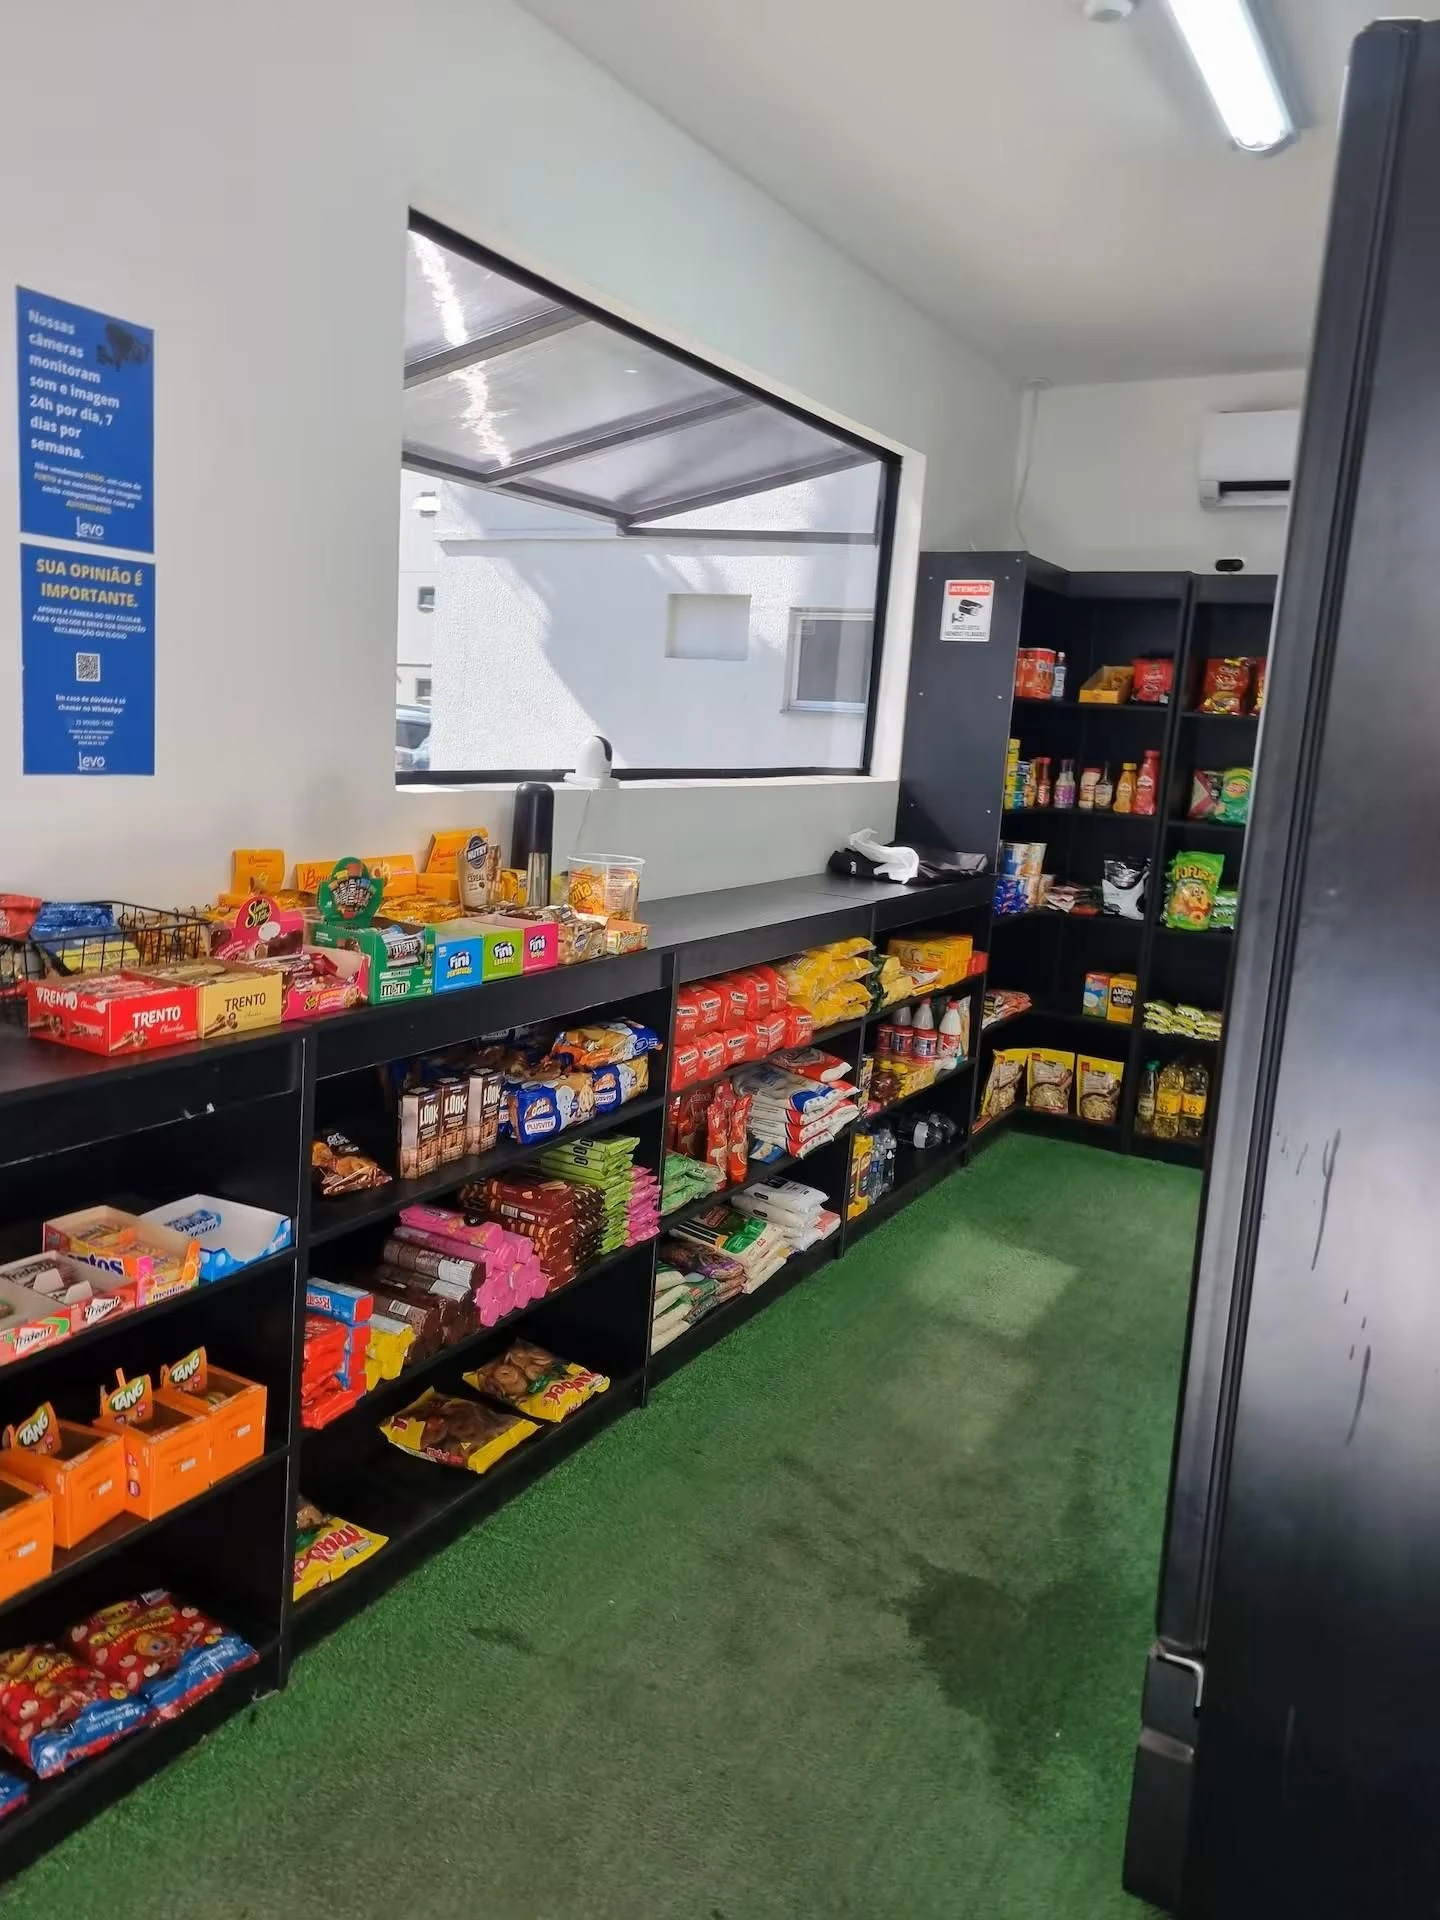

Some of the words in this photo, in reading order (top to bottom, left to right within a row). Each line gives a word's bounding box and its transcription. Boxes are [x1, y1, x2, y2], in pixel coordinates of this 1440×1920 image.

[28, 309, 75, 336] Nossas
[28, 331, 84, 359] câmeras
[29, 353, 101, 384] monitoram
[29, 375, 57, 393] som
[59, 384, 68, 396] e
[70, 384, 120, 410] imagem
[29, 394, 54, 412] 24h
[56, 402, 77, 418] por
[80, 407, 103, 426] dia,
[105, 414, 113, 427] 7
[30, 416, 57, 433] dias
[59, 423, 82, 439] por
[30, 437, 85, 460] semana.
[36, 558, 67, 577] SUA
[70, 562, 131, 585] OPINIÃO
[134, 569, 144, 587] É
[40, 582, 139, 608] IMPORTANTE.
[449, 951, 471, 969] Fini
[494, 942, 514, 959] Fini
[35, 987, 78, 1011] TRENTO
[225, 992, 267, 1012] TRENTO
[132, 1006, 181, 1030] TRENTO
[444, 1095, 468, 1117] LOOK
[483, 1085, 502, 1106] LOOK
[420, 1104, 439, 1127] LOOK
[526, 1118, 554, 1132] PLUSVITA
[84, 1296, 121, 1319] Trident
[14, 1326, 52, 1348] Trident
[171, 1354, 200, 1383] TANG
[111, 1381, 145, 1412] TANG
[19, 1412, 49, 1446] TANG
